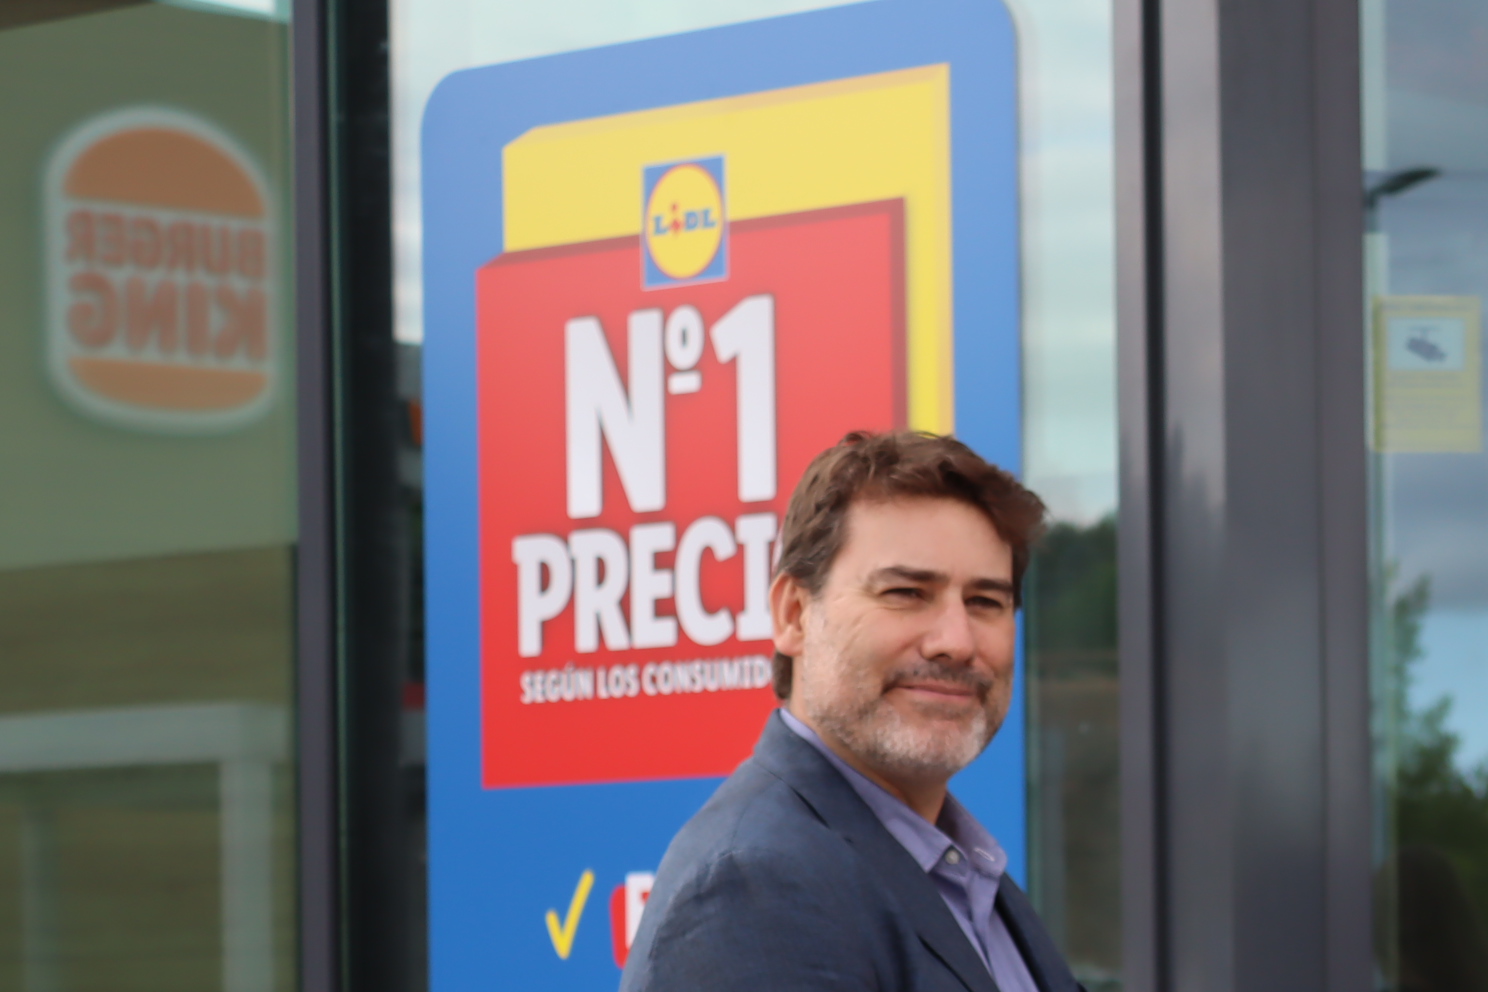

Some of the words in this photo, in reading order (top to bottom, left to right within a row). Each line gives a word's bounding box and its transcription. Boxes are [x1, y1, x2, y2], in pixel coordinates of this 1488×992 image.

[512, 512, 782, 658] PRECI
[520, 661, 595, 704] SEGÚN
[597, 663, 640, 699] LOS
[642, 654, 774, 696] CONSUMID
